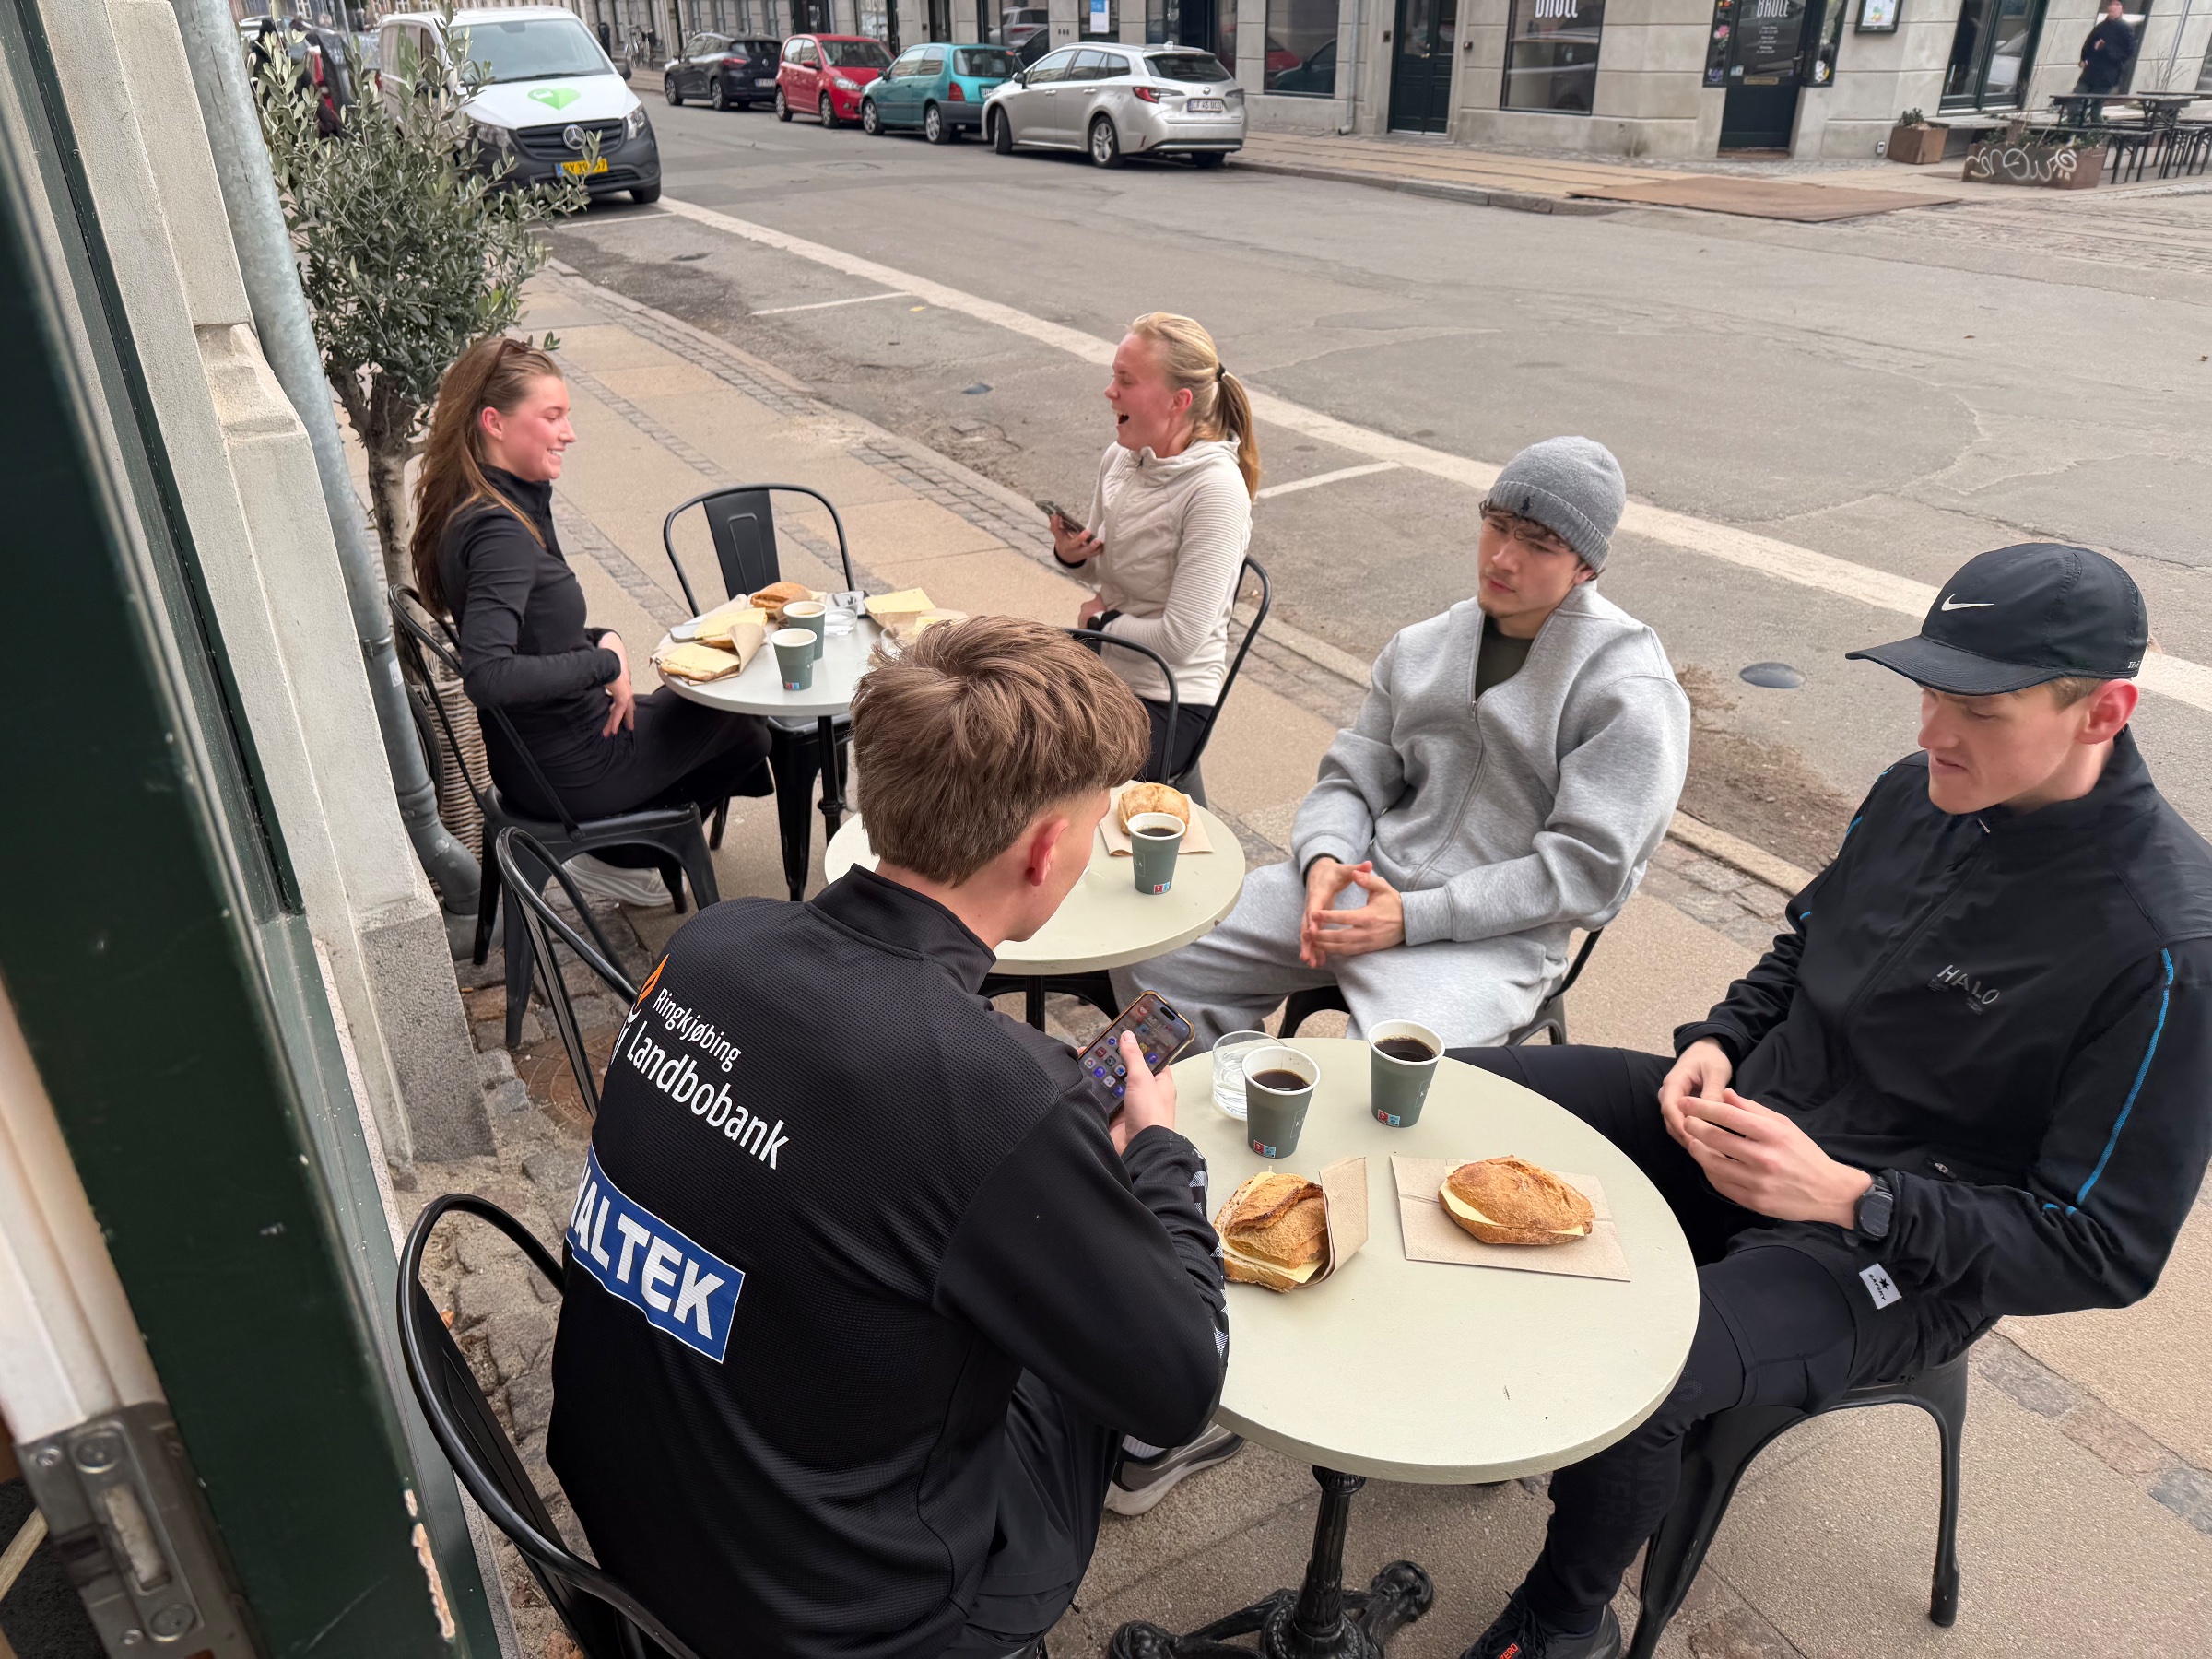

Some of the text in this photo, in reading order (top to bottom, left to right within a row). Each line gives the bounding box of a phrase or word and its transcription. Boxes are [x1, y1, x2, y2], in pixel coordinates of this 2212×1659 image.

[1936, 964, 2001, 1005] HALO
[653, 987, 742, 1073] Ringkjøbing
[626, 1020, 790, 1171] Landbobank
